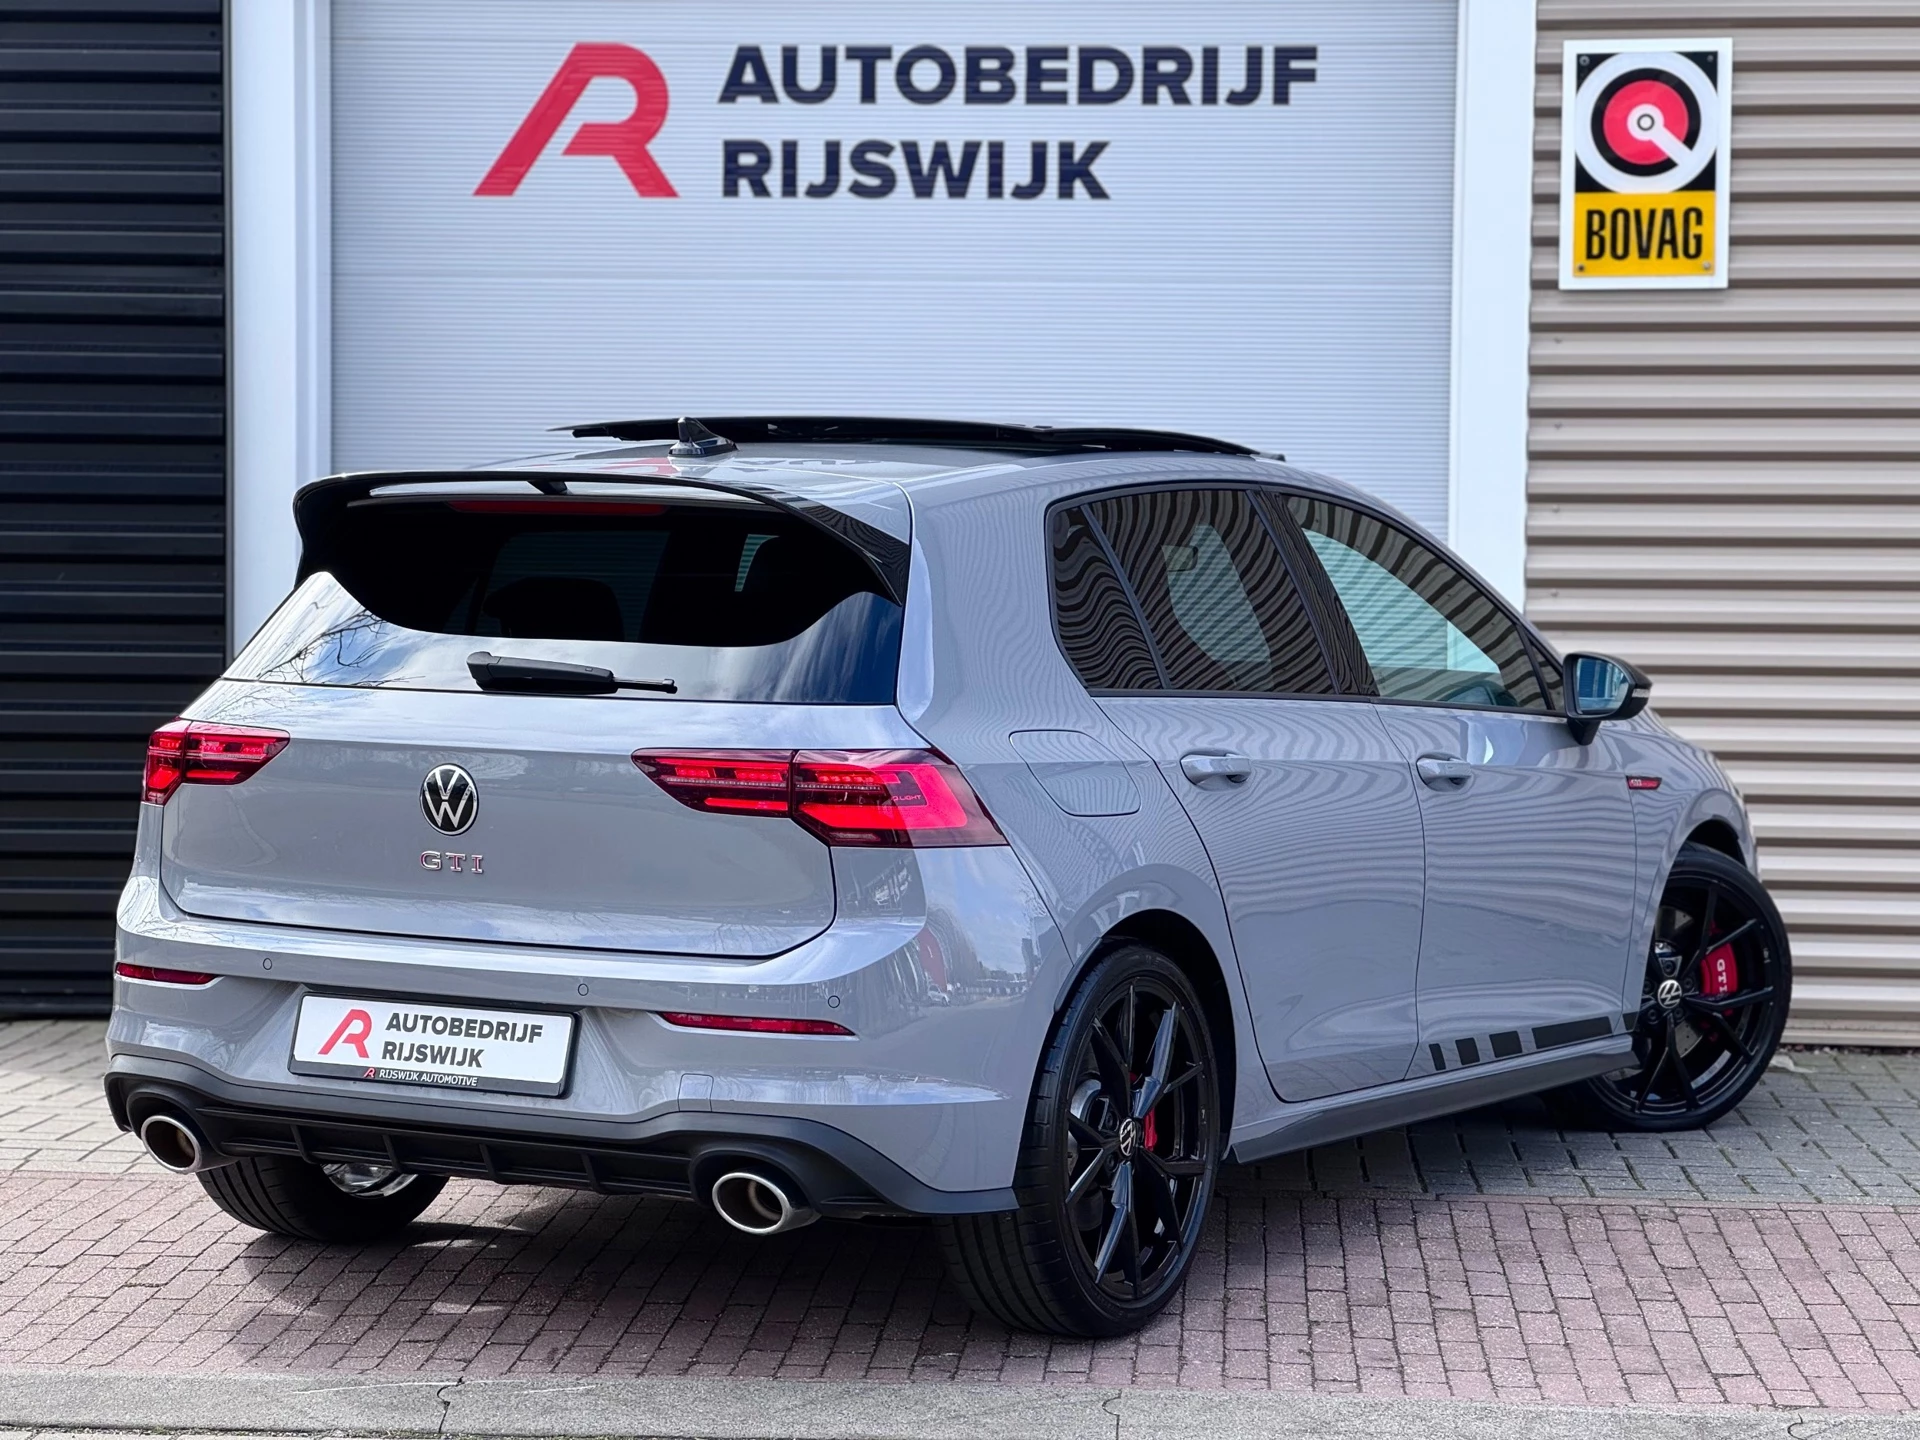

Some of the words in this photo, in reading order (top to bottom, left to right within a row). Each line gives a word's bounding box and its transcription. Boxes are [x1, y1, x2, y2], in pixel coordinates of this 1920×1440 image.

[718, 44, 1318, 106] AUTOBEDRIJF
[721, 139, 1110, 200] RIJSWIJK
[1585, 207, 1703, 260] BOVAG
[420, 850, 484, 874] GTI
[385, 1012, 544, 1044] AUTOBEDRIJF
[381, 1040, 485, 1068] RIJSWIJK
[379, 1069, 419, 1081] RIJSWIJK
[421, 1075, 478, 1087] AUTOMOTIVE
